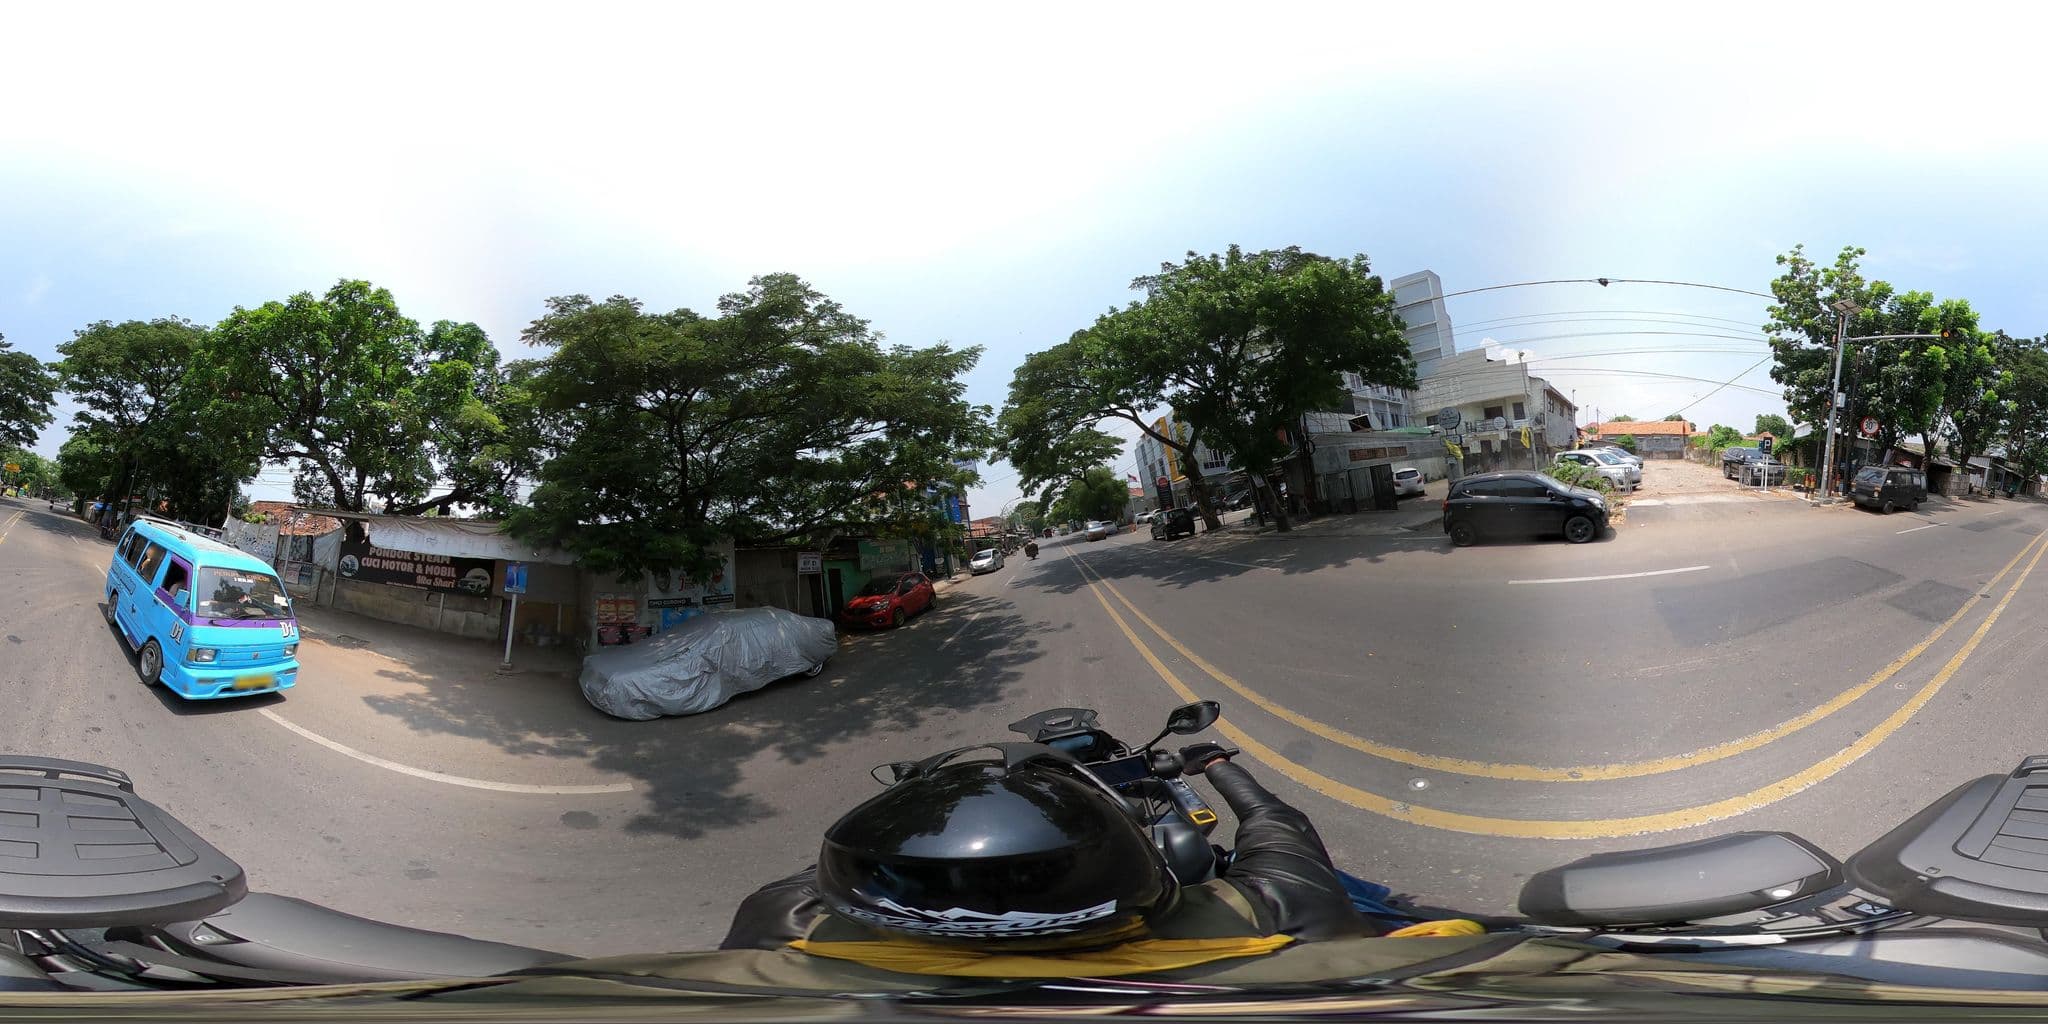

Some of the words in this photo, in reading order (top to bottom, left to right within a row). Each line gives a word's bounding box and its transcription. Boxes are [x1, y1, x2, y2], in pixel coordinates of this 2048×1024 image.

[1764, 439, 1771, 449] P
[369, 547, 411, 560] PONDOK
[414, 551, 451, 564] STEAM
[361, 557, 380, 568] CUCI
[382, 559, 414, 573] MOTOR
[416, 564, 423, 575] &
[425, 565, 456, 578] MOBIL
[170, 621, 185, 646] D1
[280, 621, 295, 638] D1
